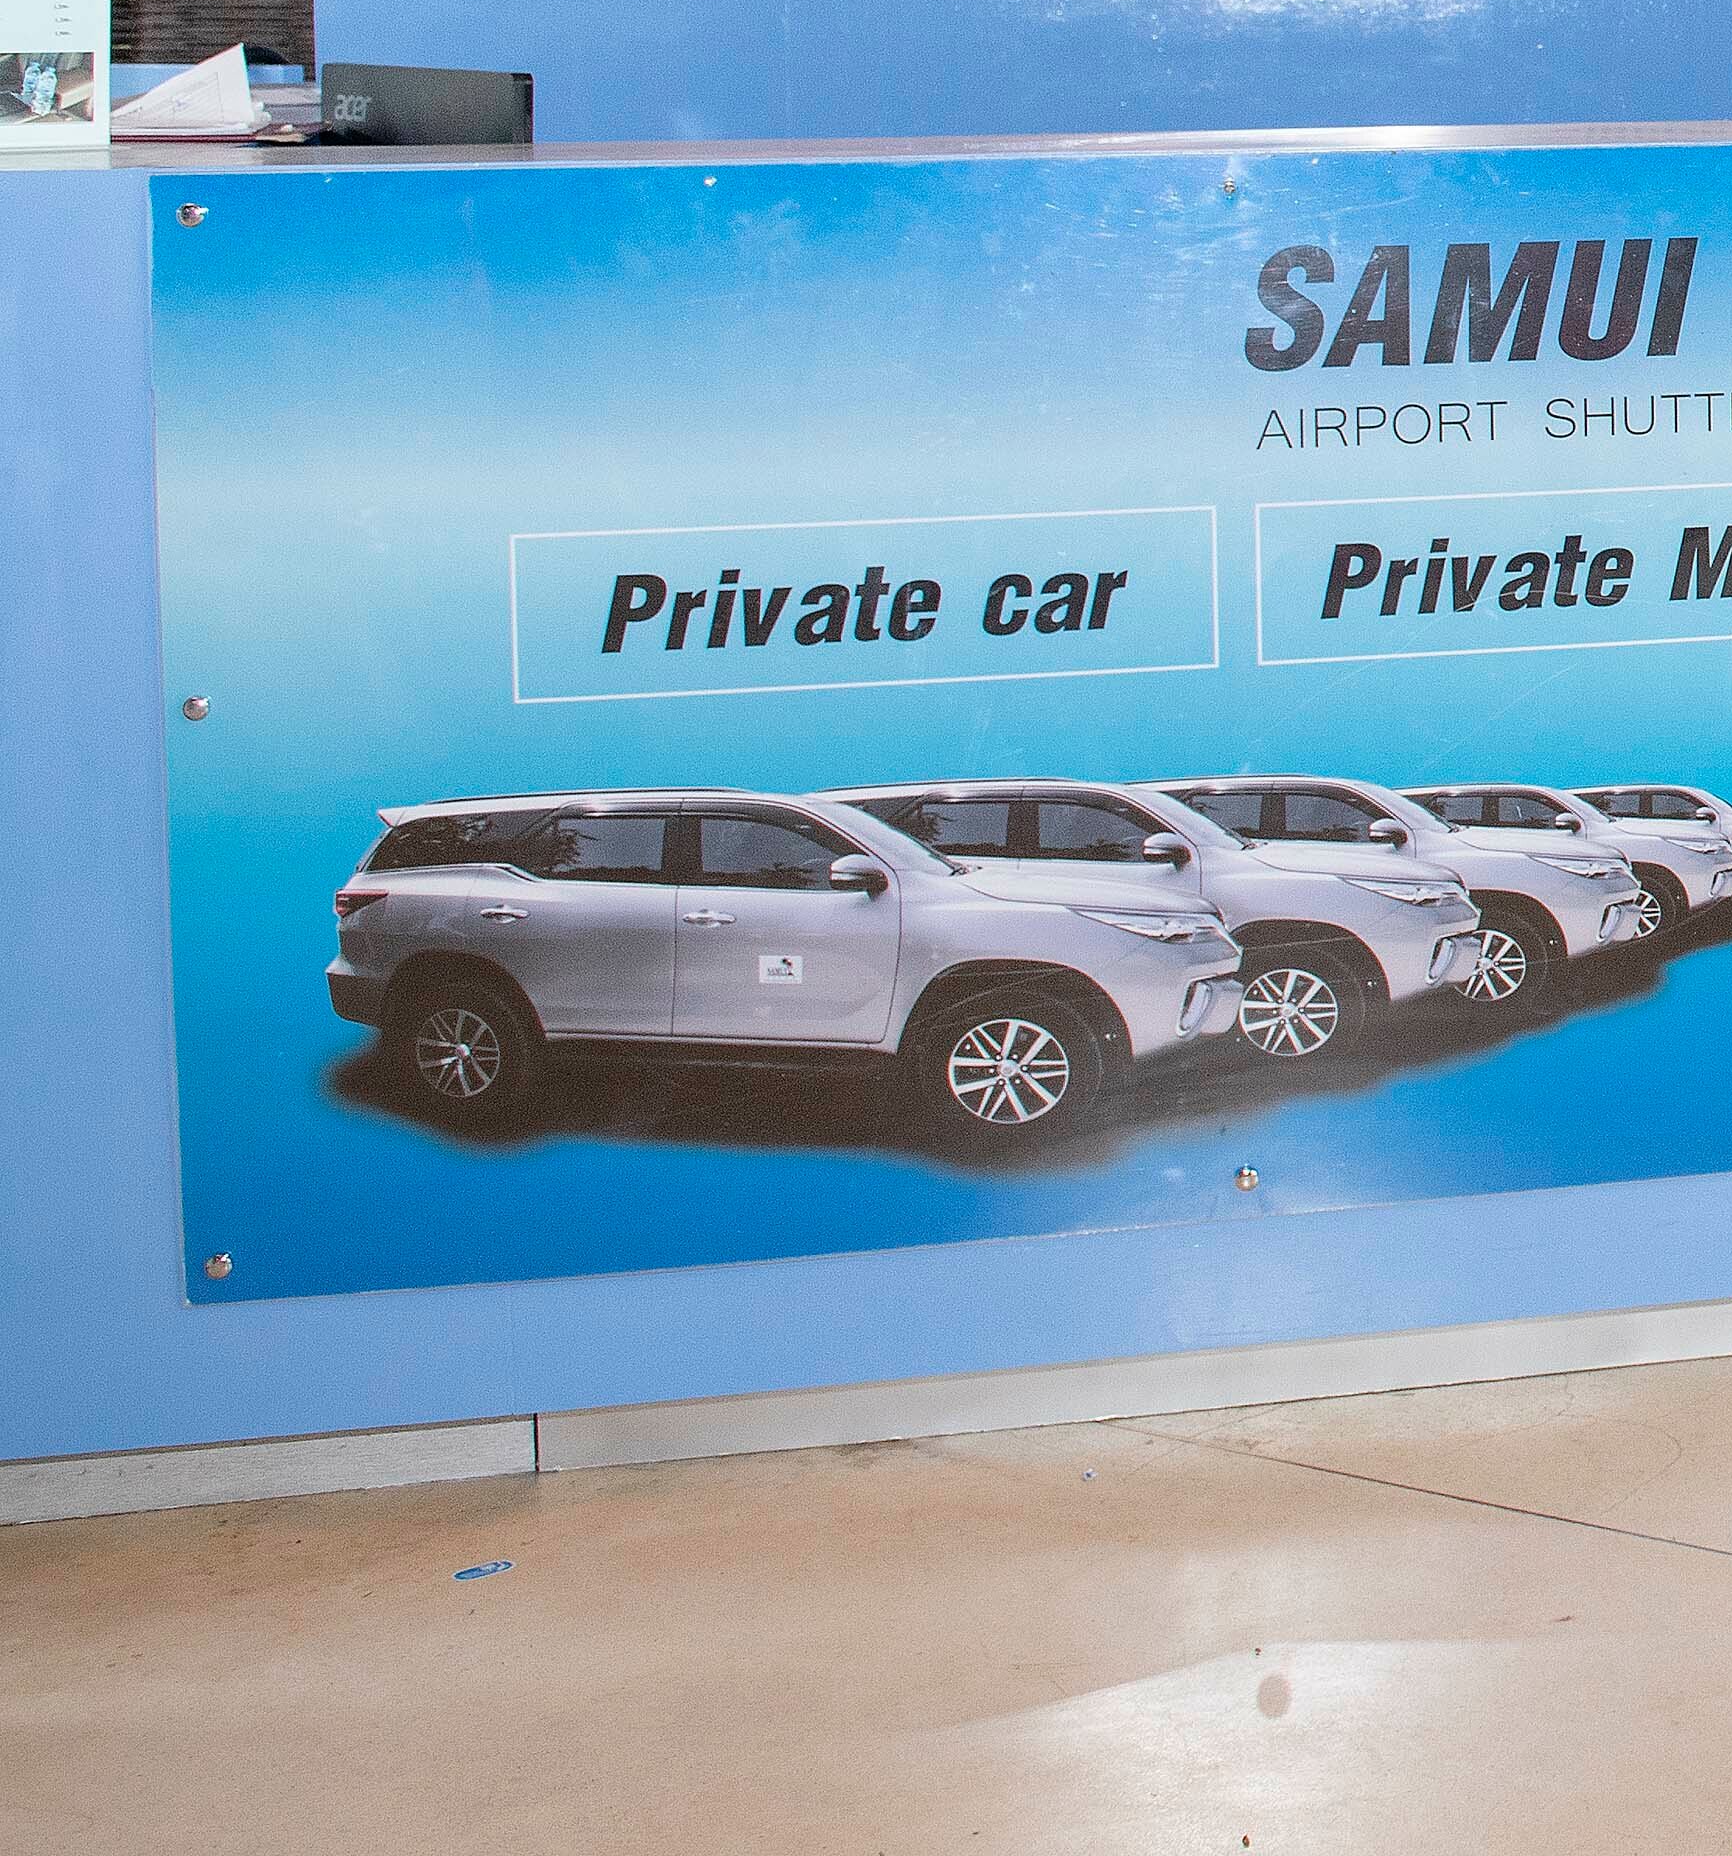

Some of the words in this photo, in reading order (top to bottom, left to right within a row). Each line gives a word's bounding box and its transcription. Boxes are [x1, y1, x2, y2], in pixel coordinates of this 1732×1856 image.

[334, 94, 372, 122] acer
[1245, 235, 1697, 373] SAMUI
[1256, 400, 1508, 450] AIRPORT
[601, 564, 942, 654] Private
[982, 568, 1128, 633] car
[1321, 528, 1633, 619] Private
